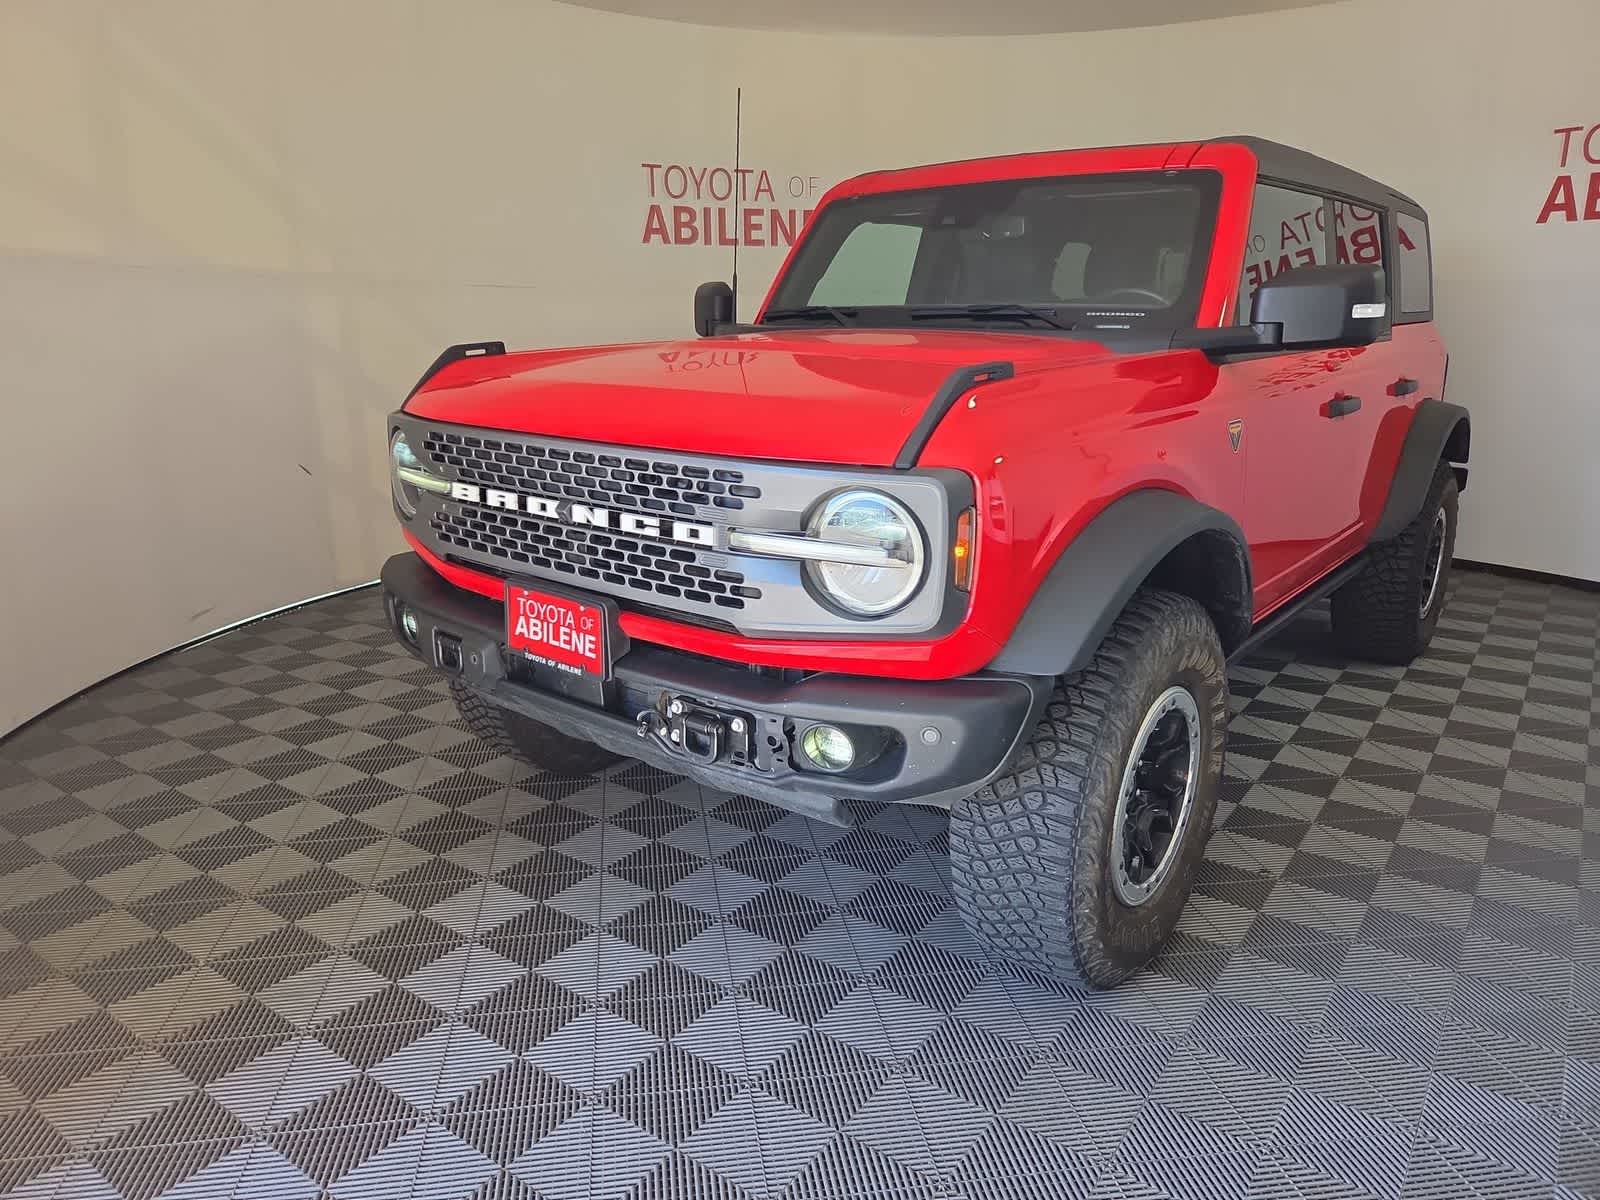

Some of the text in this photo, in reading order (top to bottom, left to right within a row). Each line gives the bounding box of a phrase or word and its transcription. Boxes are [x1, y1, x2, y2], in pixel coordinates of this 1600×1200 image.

[641, 163, 821, 202] TOYOTA OF
[452, 482, 717, 547] BRONCO
[516, 597, 594, 631] TOYOTA OF
[514, 616, 597, 659] ABILENE
[524, 652, 582, 676] TOYOTA OF ABILENE
